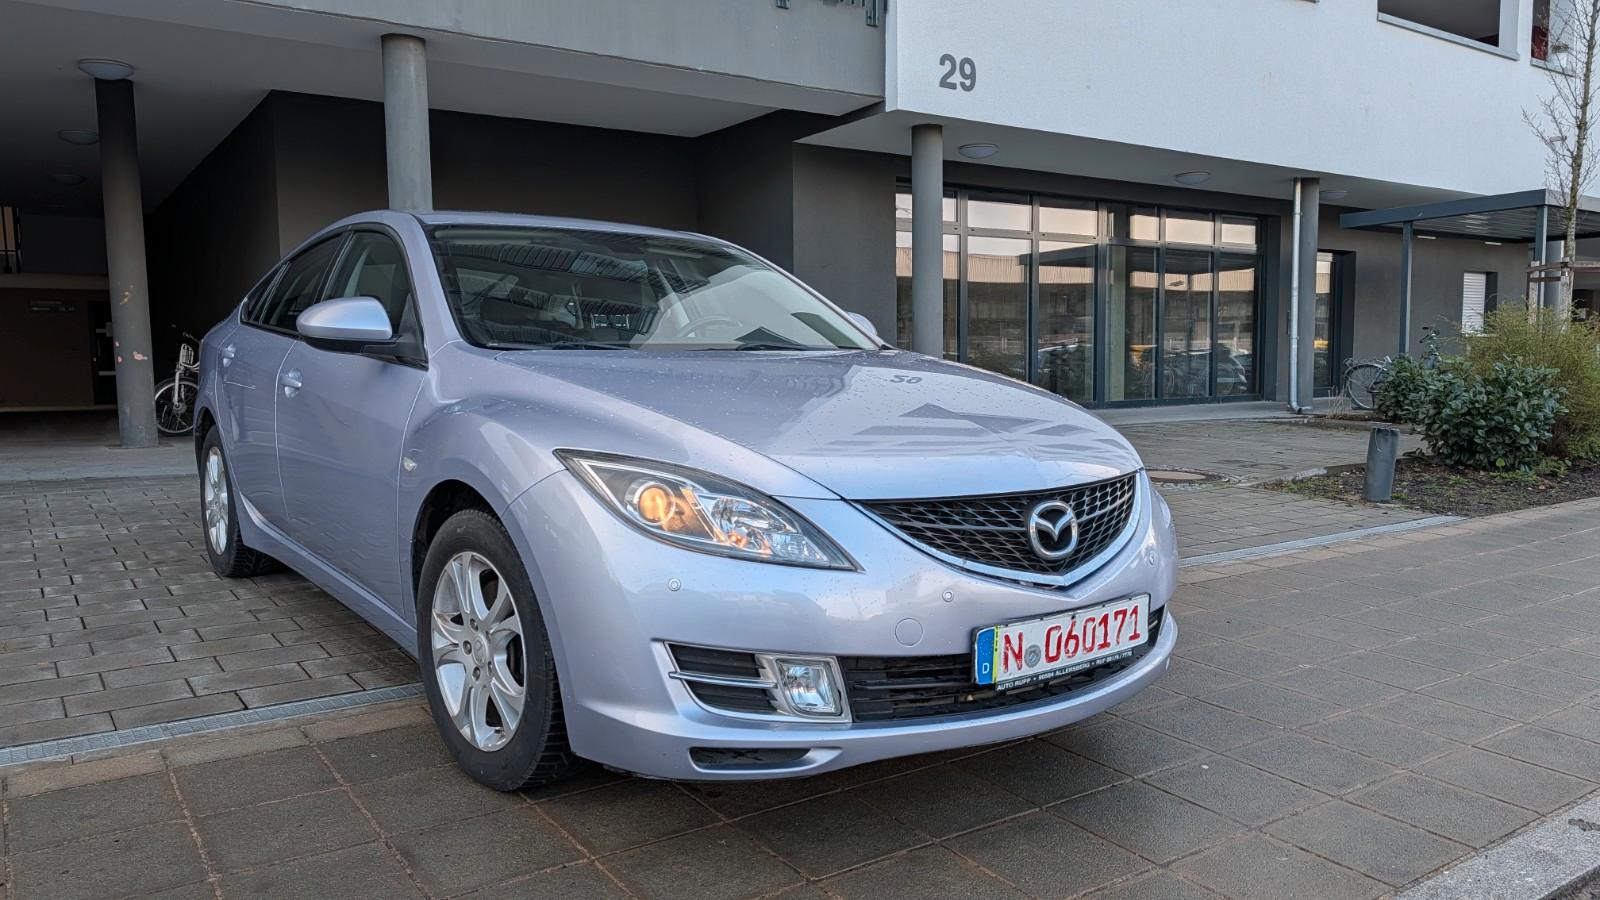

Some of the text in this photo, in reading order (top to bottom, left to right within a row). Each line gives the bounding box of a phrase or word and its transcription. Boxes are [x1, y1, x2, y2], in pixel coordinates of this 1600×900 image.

[939, 53, 977, 92] 29
[1003, 631, 1024, 673] N
[1045, 604, 1141, 663] 060171
[982, 662, 990, 674] D
[996, 681, 1014, 691] AUTO
[1014, 677, 1032, 687] RUPP
[1055, 662, 1090, 677] ALLERSBERG
